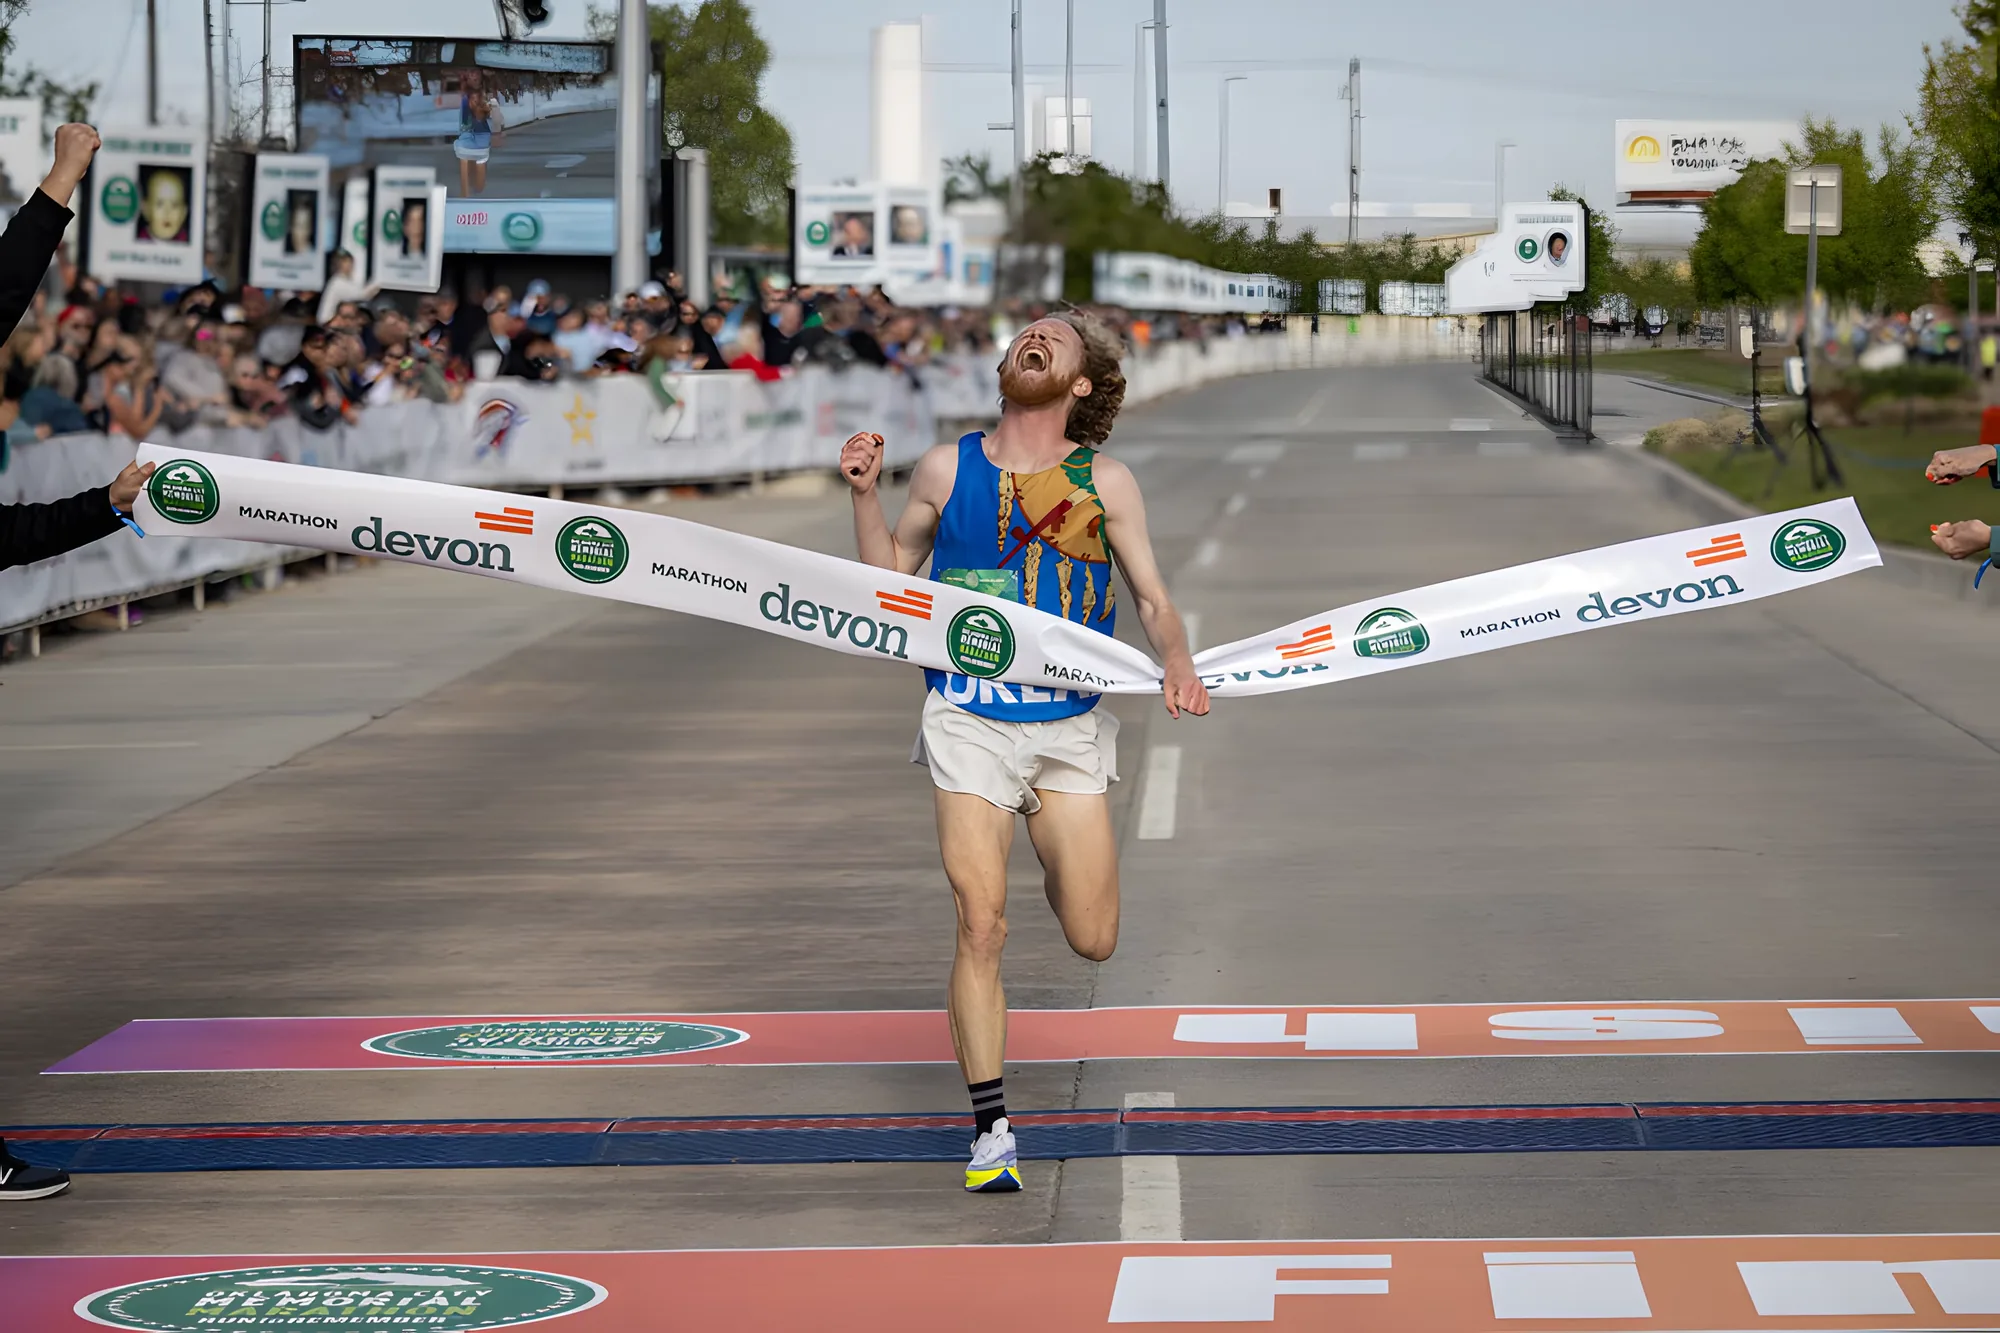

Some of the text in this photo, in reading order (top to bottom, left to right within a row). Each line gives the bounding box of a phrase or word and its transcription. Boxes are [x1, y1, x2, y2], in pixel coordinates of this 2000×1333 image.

[239, 505, 339, 531] MARATHON
[351, 516, 515, 573] devon
[651, 562, 748, 595] MARATHON
[1576, 574, 1746, 622] devon
[759, 582, 910, 660] devon
[1459, 608, 1562, 640] MARATHON
[193, 1296, 483, 1307] MEMORIAL
